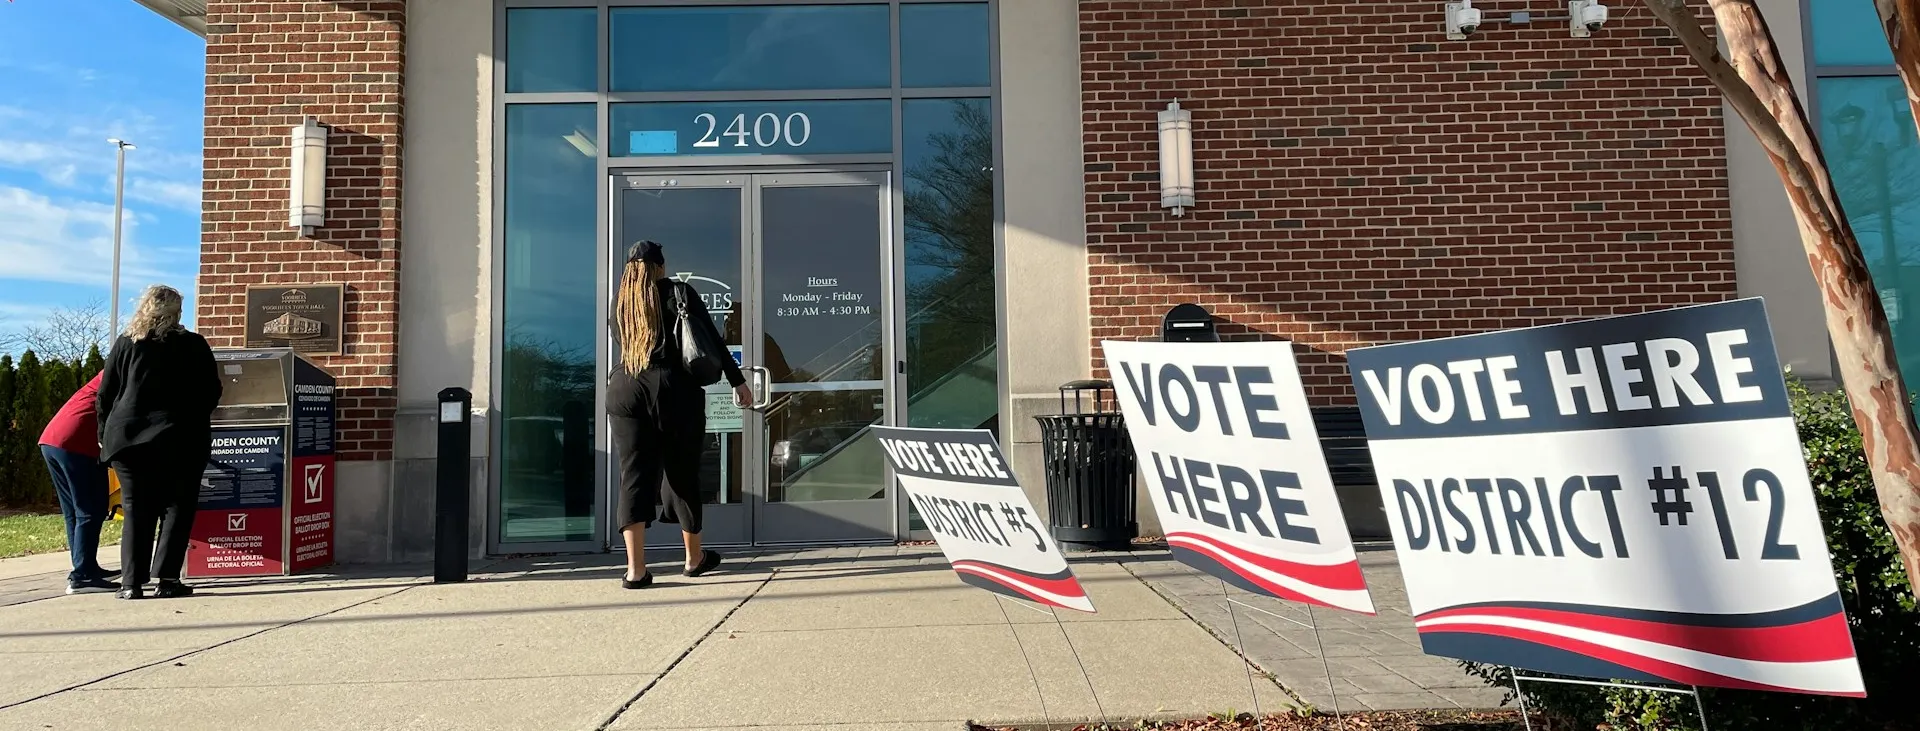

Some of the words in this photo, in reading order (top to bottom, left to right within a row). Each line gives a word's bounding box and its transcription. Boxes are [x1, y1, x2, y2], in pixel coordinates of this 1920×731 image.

[693, 112, 811, 148] 2400
[782, 292, 822, 303] Monday
[832, 292, 862, 302] Friday
[807, 276, 838, 286] Hours
[777, 307, 799, 316] 8:30
[802, 307, 818, 316] AM
[830, 306, 852, 315] 4:30
[854, 306, 870, 314] PM
[294, 384, 315, 394] CAMDEN
[316, 385, 334, 394] COUNTY
[1361, 354, 1530, 426] VOTE
[1544, 328, 1764, 416] HERE
[1120, 361, 1290, 440] VOTE
[211, 438, 236, 447] MDEN
[238, 436, 280, 446] COUNTY
[878, 438, 943, 474] VOTE
[934, 442, 1008, 479] HERE
[1151, 451, 1321, 545] HERE
[1392, 475, 1630, 559] DISTRICT
[1647, 465, 1801, 560] #12
[914, 492, 1012, 547] DISTRICT
[999, 502, 1047, 552] #5
